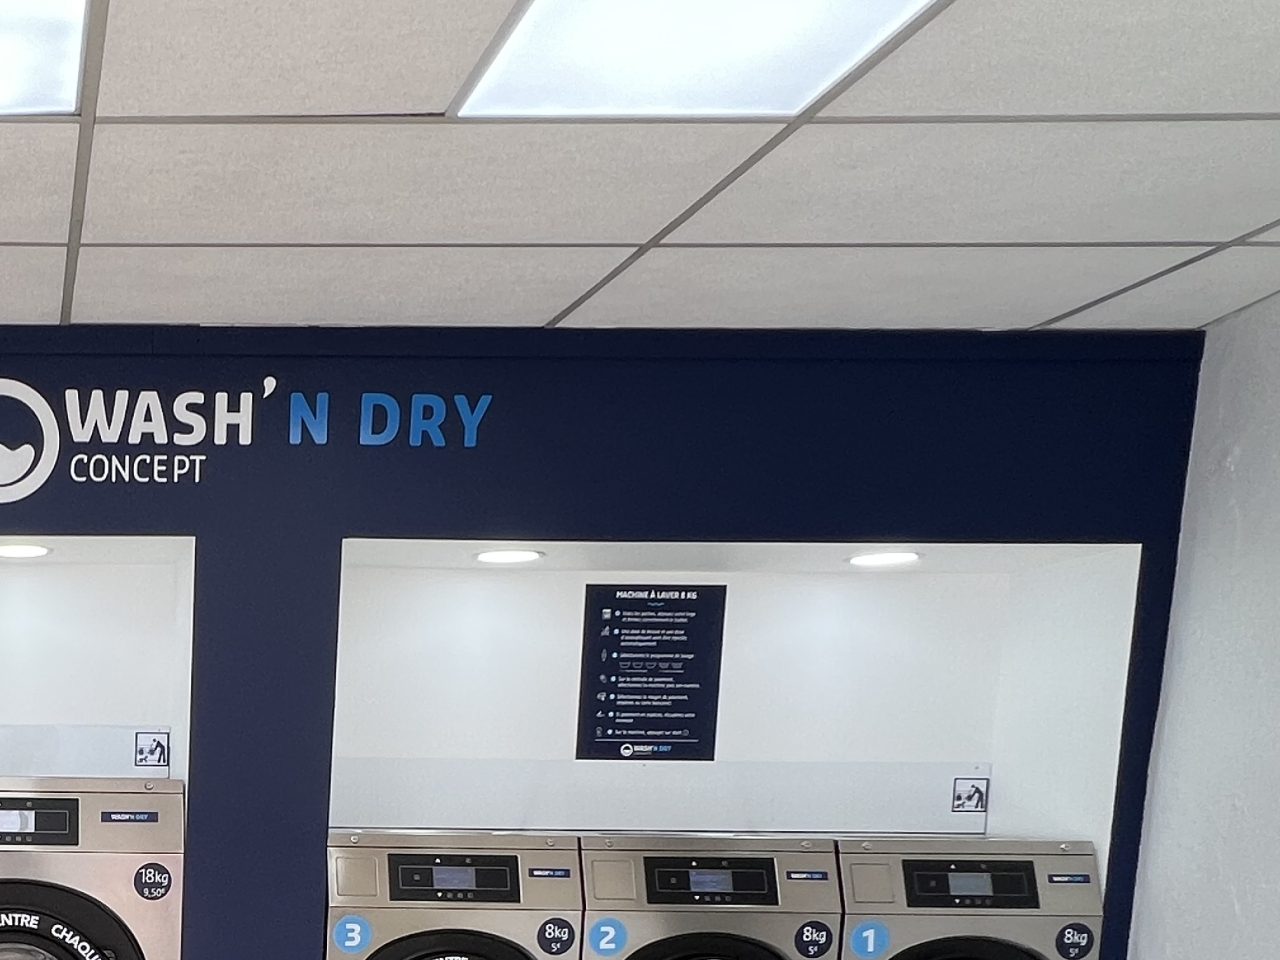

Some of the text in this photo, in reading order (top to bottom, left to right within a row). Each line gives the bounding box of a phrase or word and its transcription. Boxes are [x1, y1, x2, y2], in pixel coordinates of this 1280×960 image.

[359, 393, 493, 448] DRY
[70, 453, 206, 483] CONCEPT
[139, 869, 169, 886] 18kg
[343, 924, 362, 946] 3
[545, 923, 568, 940] 8kg
[598, 926, 618, 948] 2
[803, 927, 827, 944] 8kg
[862, 929, 876, 951] 1
[1064, 929, 1088, 945] 8kg
